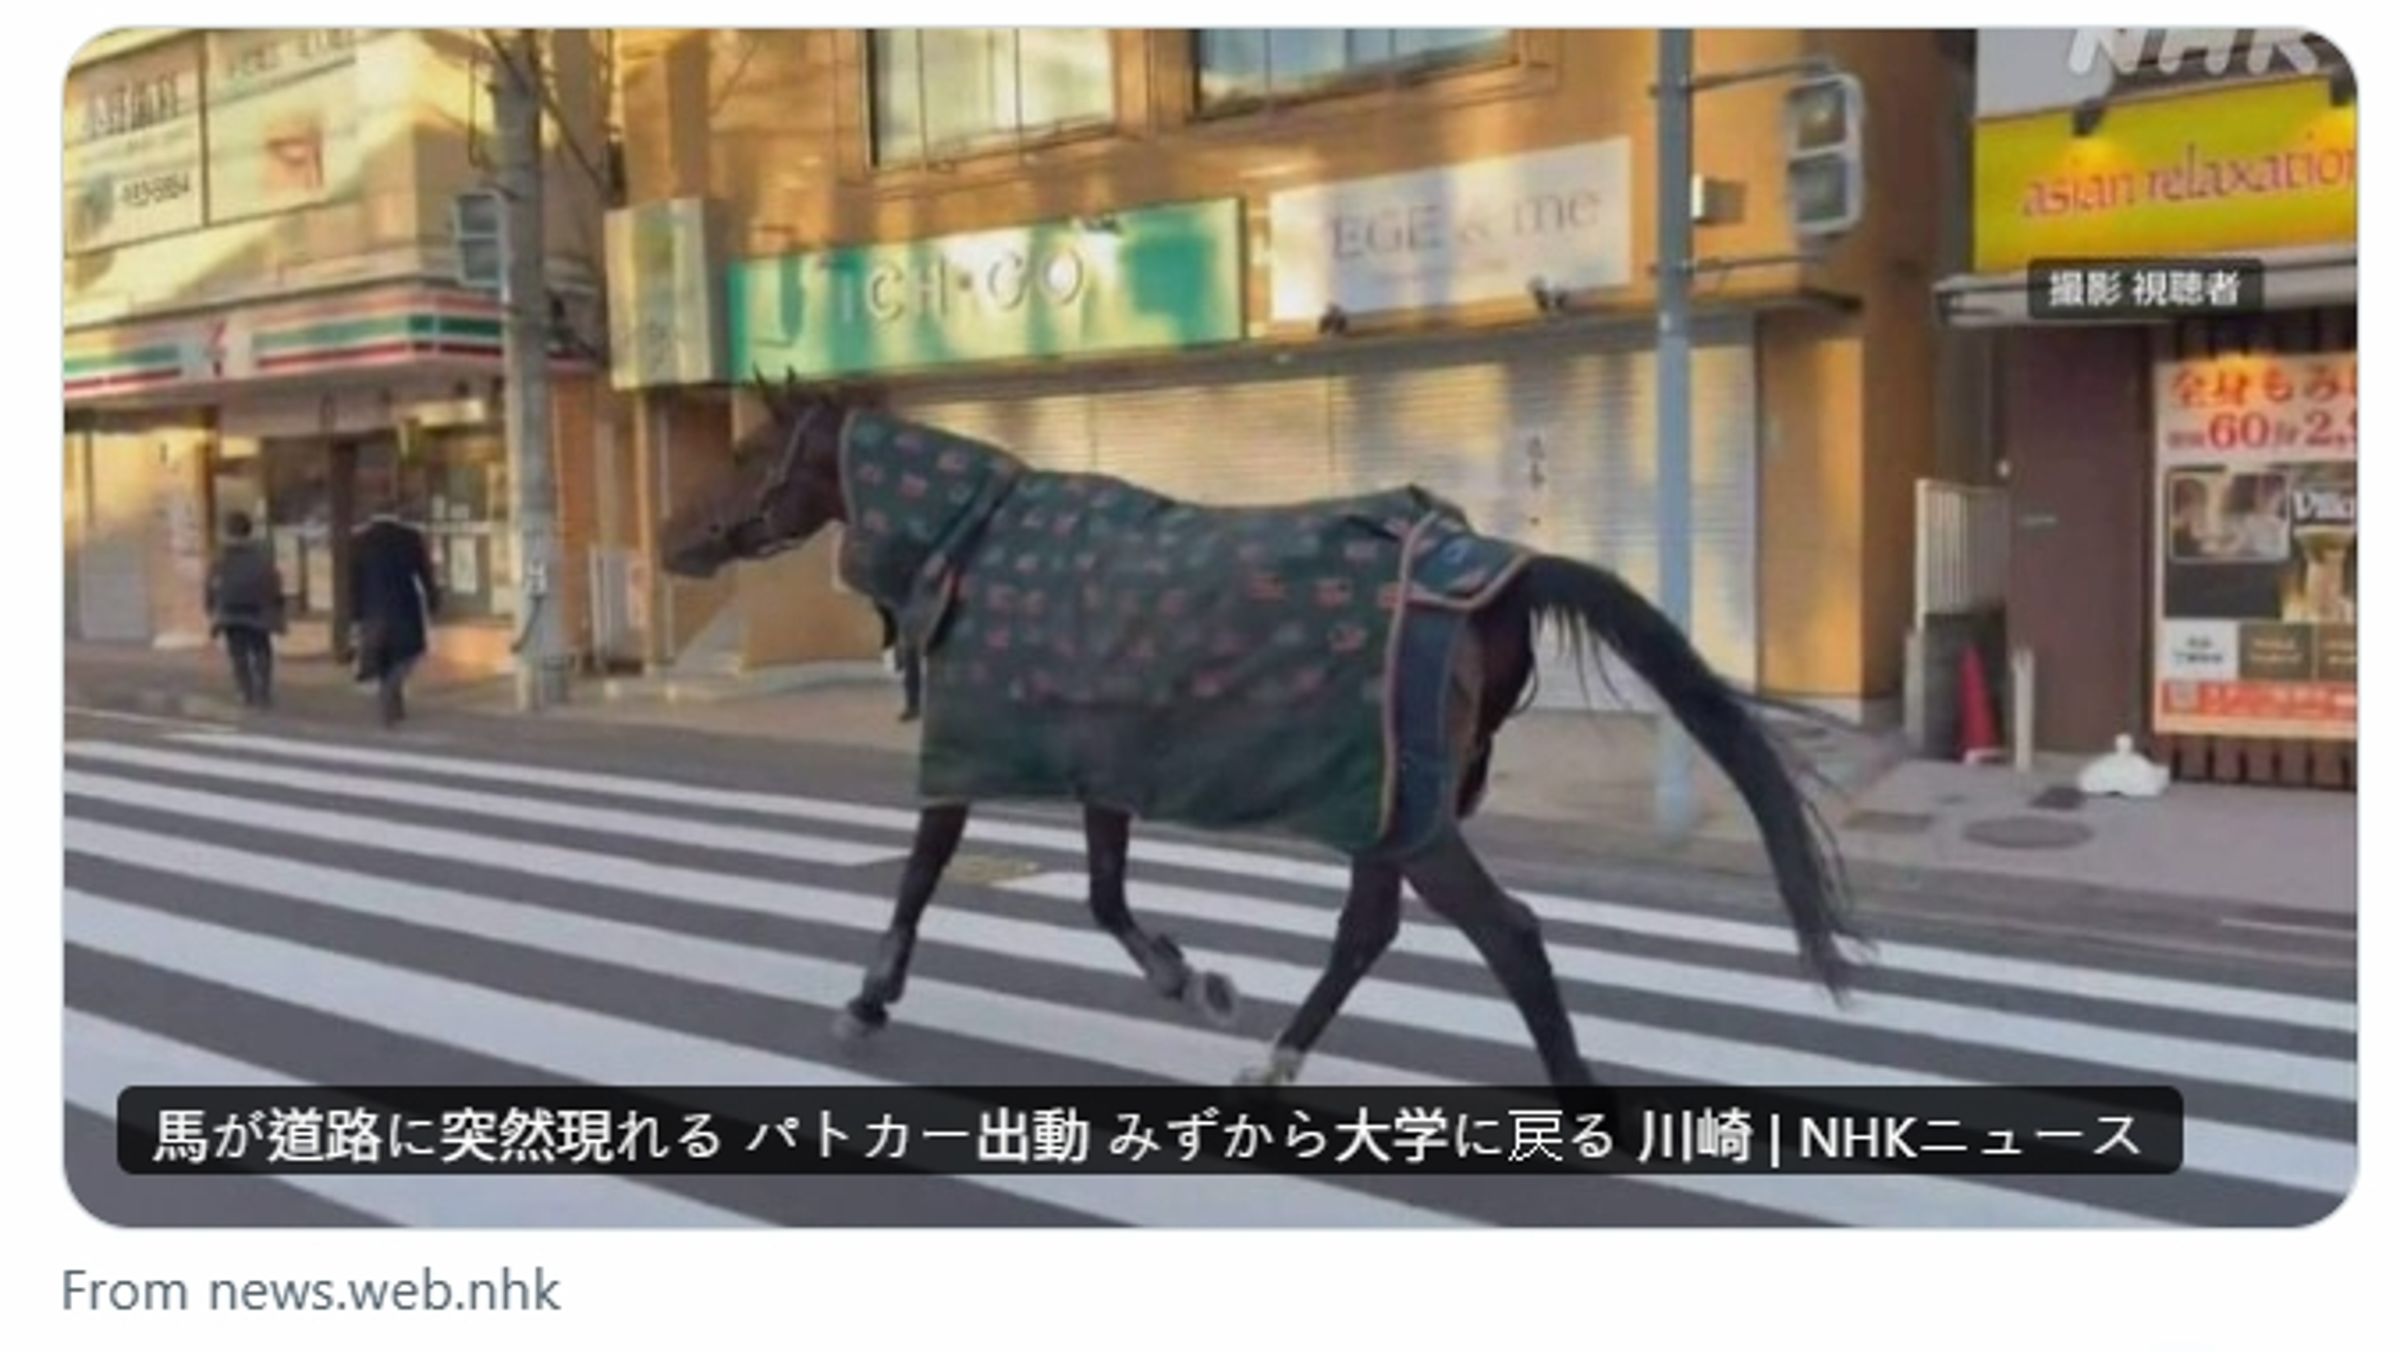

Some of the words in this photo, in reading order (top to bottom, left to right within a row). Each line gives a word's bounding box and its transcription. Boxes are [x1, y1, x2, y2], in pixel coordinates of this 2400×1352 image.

[2022, 158, 2137, 216] asian
[1330, 202, 1442, 260] EGE
[2170, 362, 2357, 409] 全身もみ
